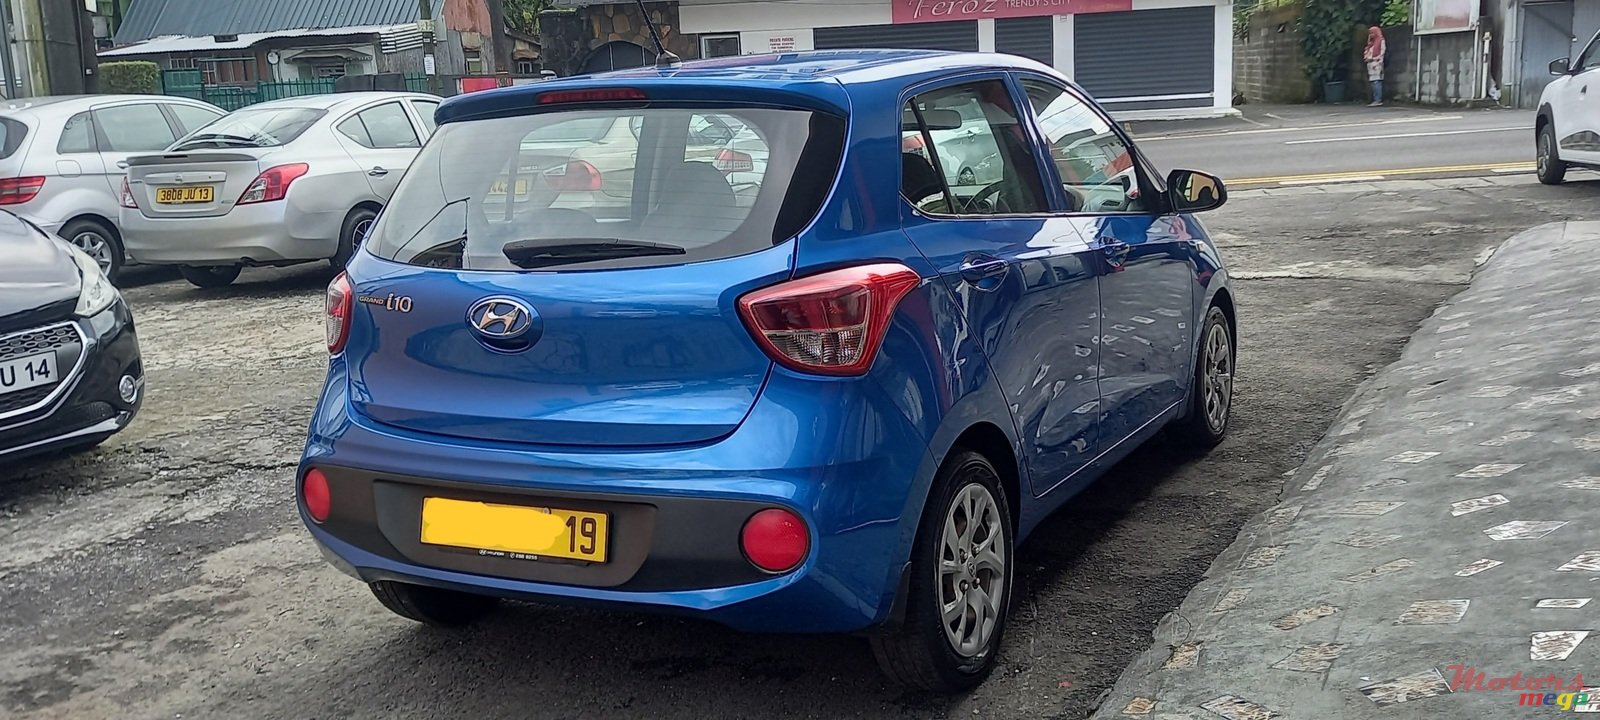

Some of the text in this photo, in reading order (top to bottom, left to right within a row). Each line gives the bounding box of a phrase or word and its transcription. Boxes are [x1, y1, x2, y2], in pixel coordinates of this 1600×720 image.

[908, 0, 997, 19] Feroz
[160, 188, 209, 201] 3808 JU 13
[359, 292, 412, 312] GRAND i10
[0, 358, 50, 387] U 14
[565, 515, 597, 555] 19
